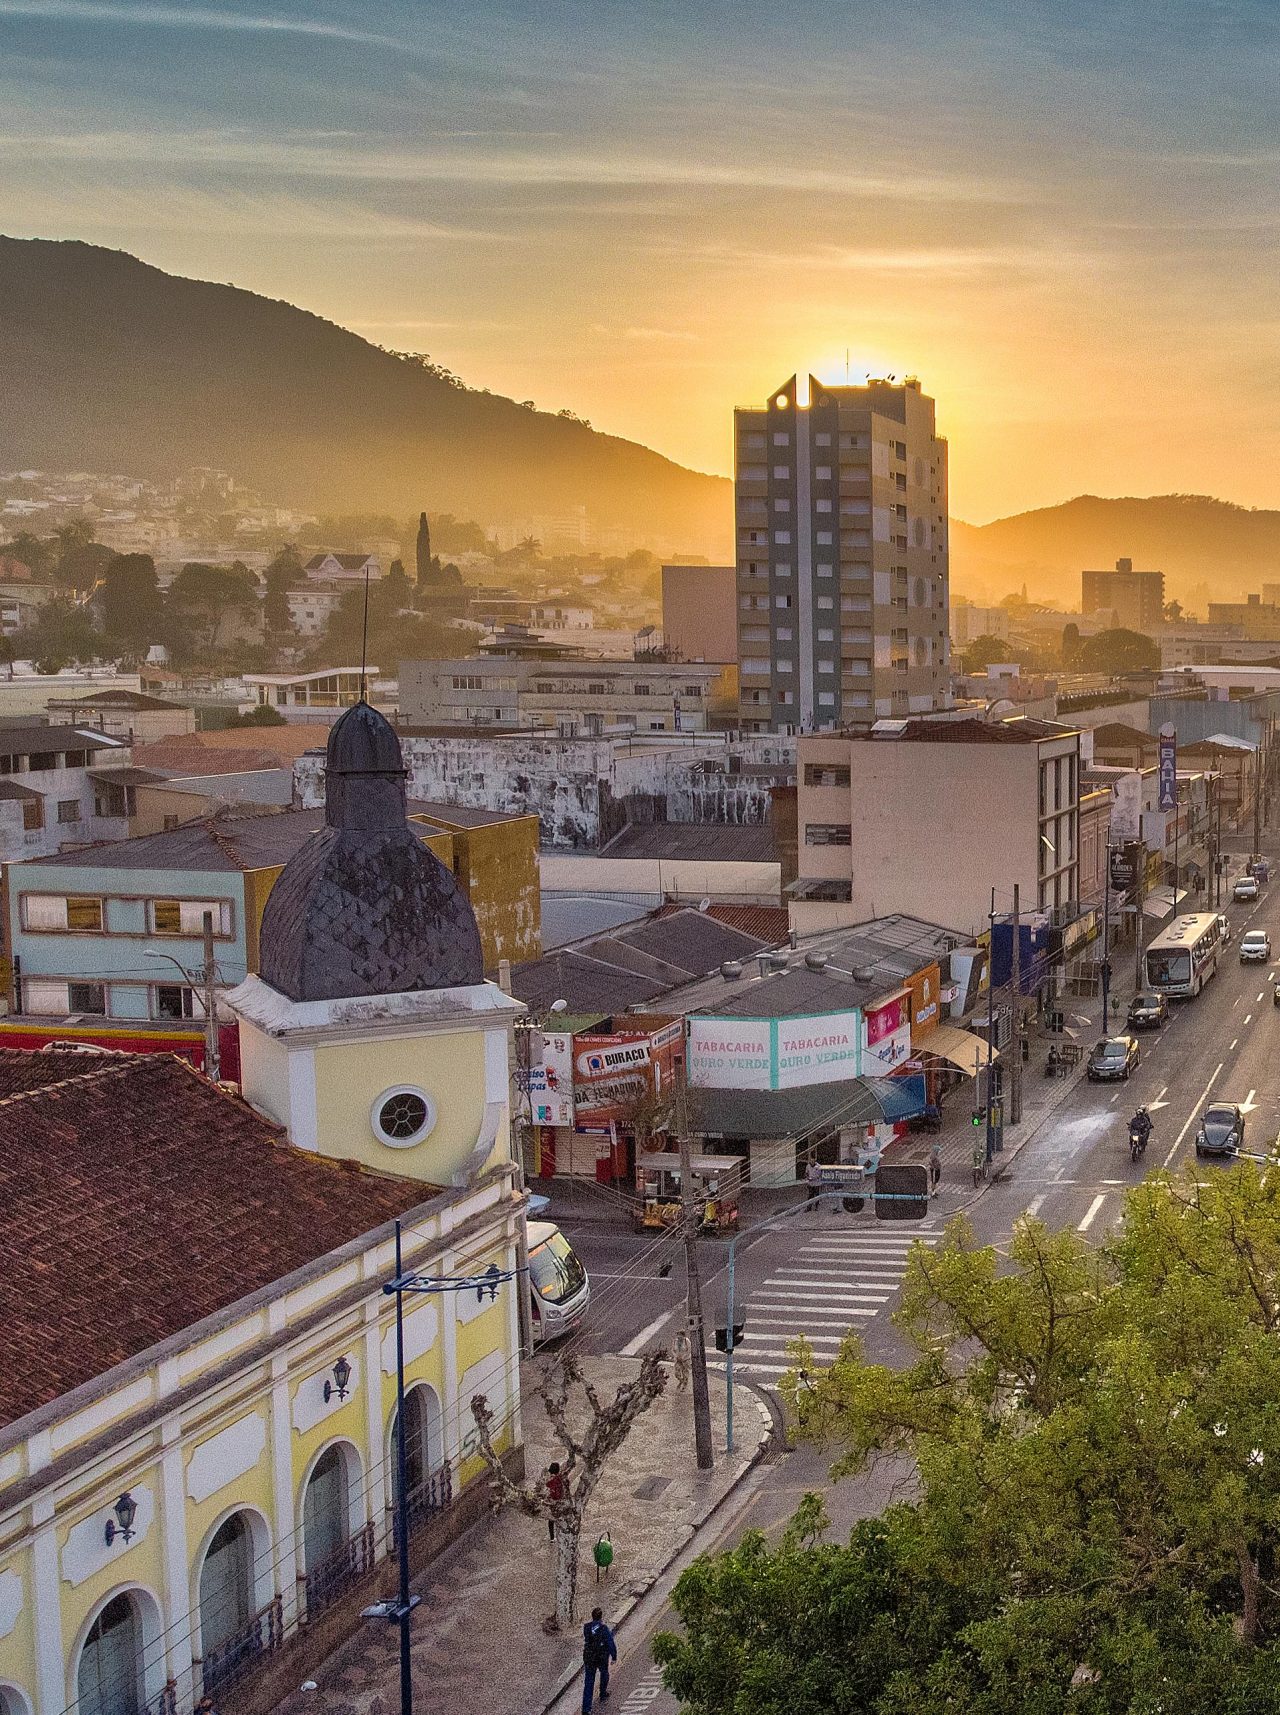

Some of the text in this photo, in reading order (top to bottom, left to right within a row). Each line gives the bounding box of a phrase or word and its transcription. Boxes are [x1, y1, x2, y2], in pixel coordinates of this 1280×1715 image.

[1161, 748, 1175, 804] BAHIA
[695, 1041, 765, 1053] TABACARIA
[783, 1034, 849, 1052] TABACARIA
[604, 1048, 645, 1066] BURACO
[693, 1057, 770, 1070] OURO VERDE
[780, 1050, 855, 1069] OURO VERDE
[576, 1091, 589, 1104] DA
